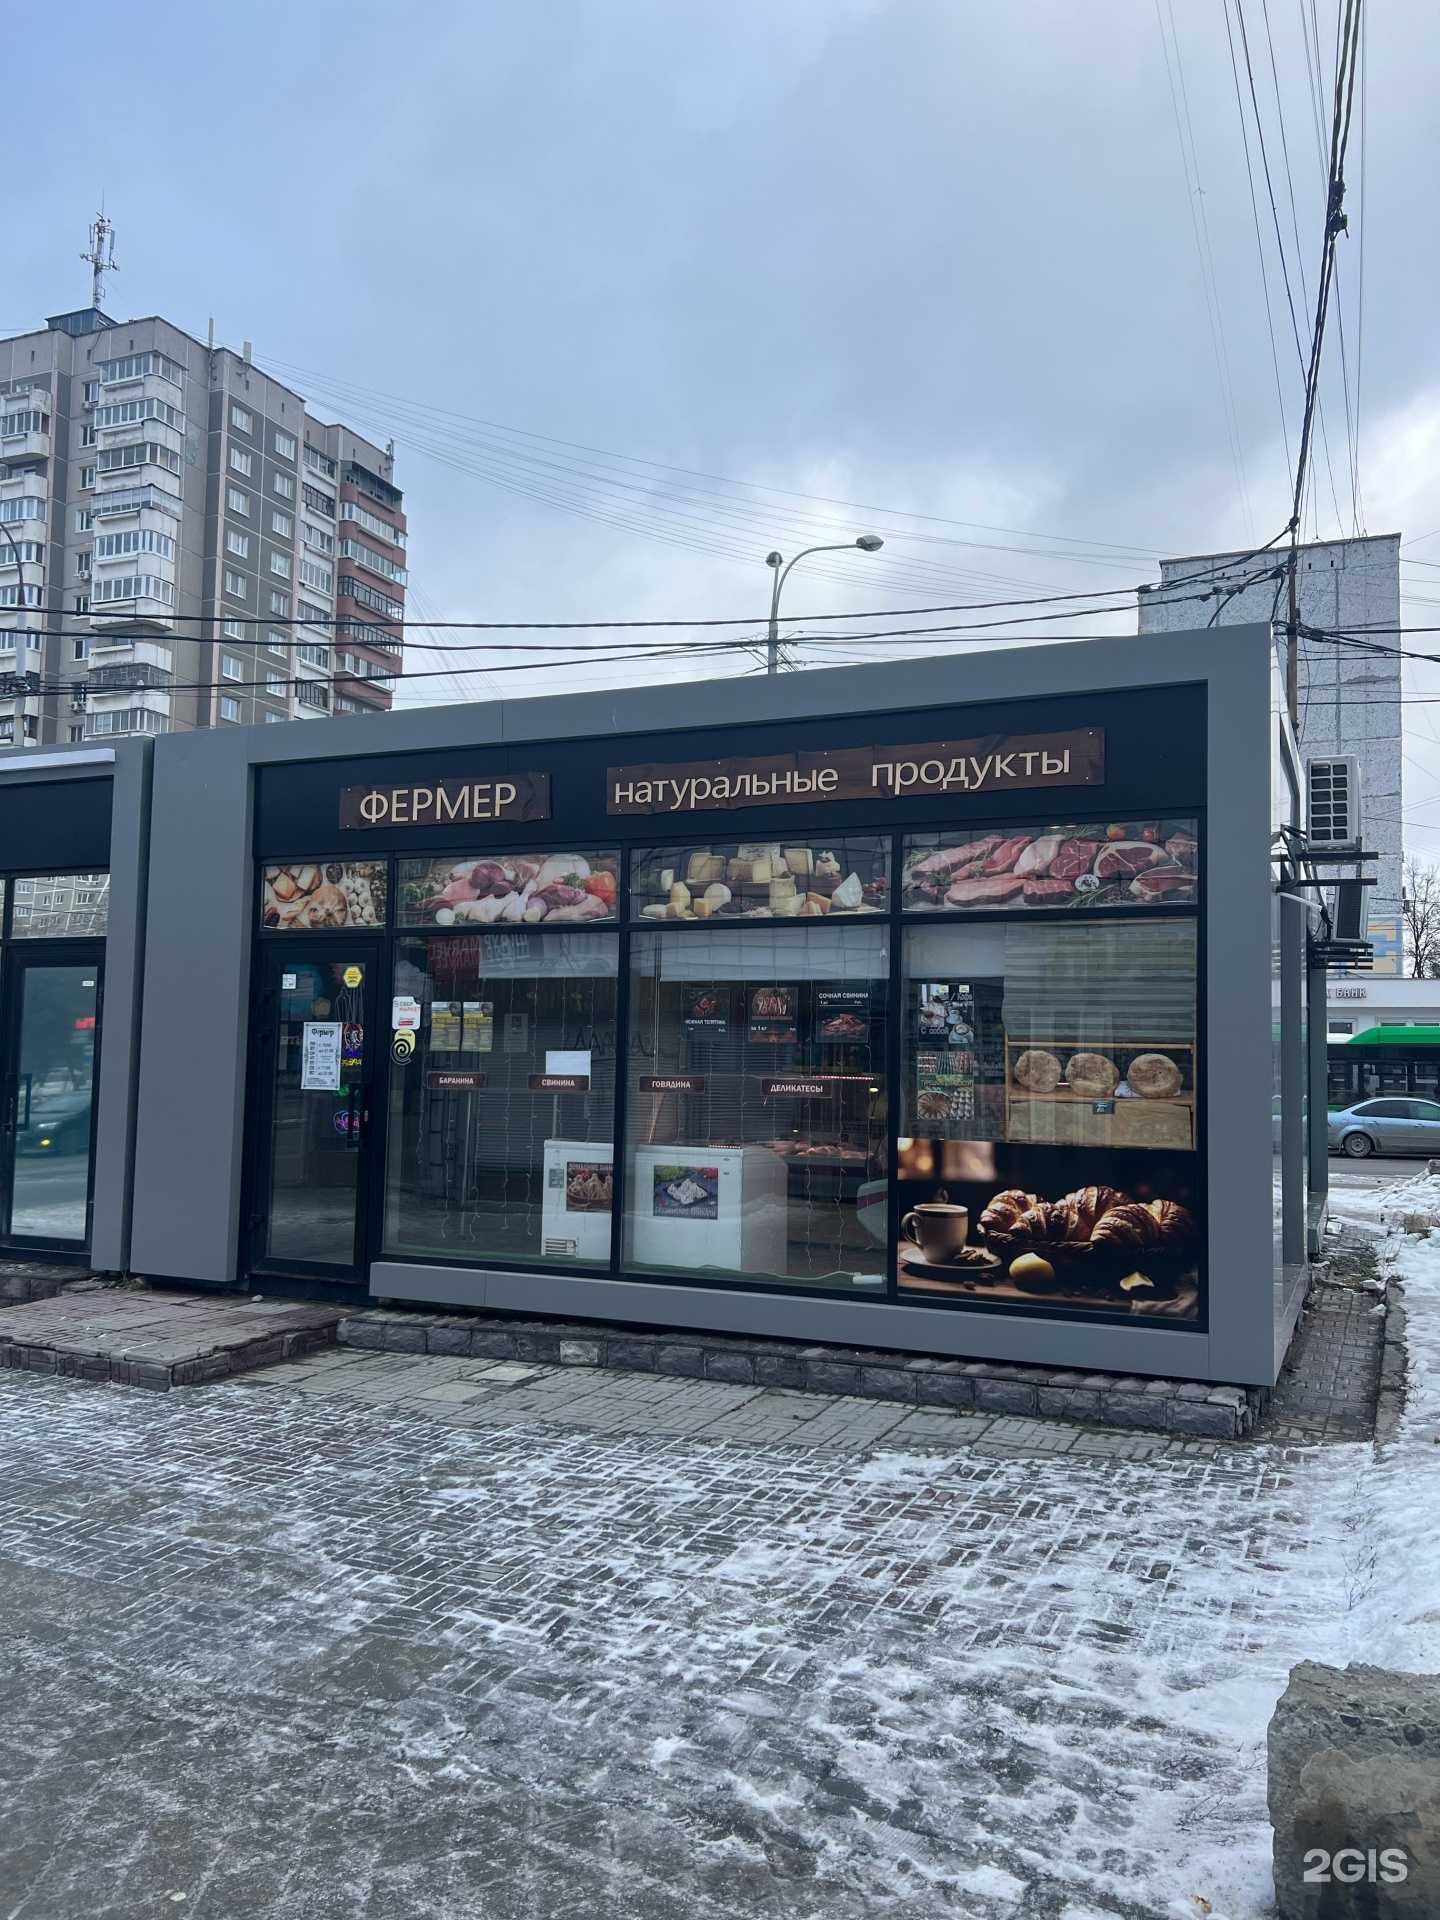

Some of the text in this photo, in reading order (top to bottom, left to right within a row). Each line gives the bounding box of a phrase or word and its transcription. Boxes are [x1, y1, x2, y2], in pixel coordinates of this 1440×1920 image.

[615, 749, 1071, 810] натуральные продукты
[359, 782, 518, 824] ФЕРМЕР
[1335, 987, 1367, 999] БАНК
[439, 1076, 474, 1085] БАРАНИНА
[541, 1078, 576, 1087] СВИНИНА
[651, 1080, 691, 1089] ГОВЯДИНА
[770, 1083, 823, 1093] ДЕЛИКАТЕСЫ
